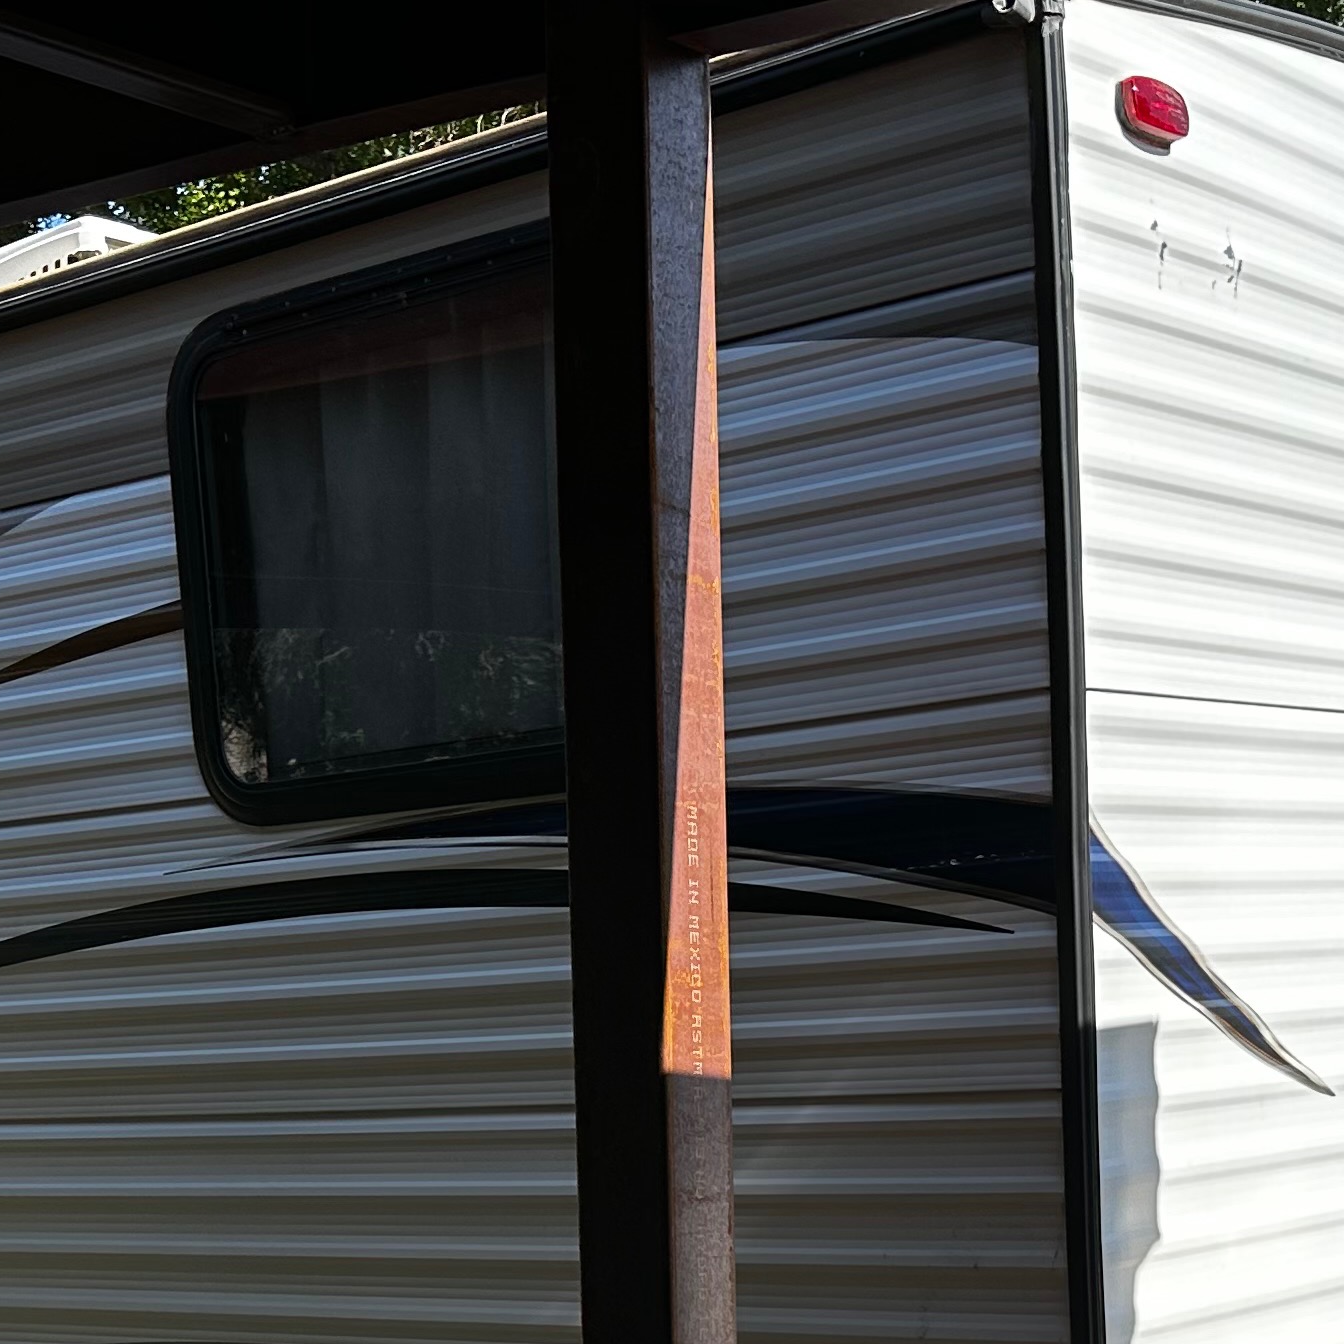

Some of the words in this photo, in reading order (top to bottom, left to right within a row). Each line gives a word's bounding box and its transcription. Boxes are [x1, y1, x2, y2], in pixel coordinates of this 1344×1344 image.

[686, 805, 699, 867] MADE
[687, 878, 700, 905] IN
[688, 914, 702, 1003] MEXICO
[690, 1014, 703, 1076] ASTM
